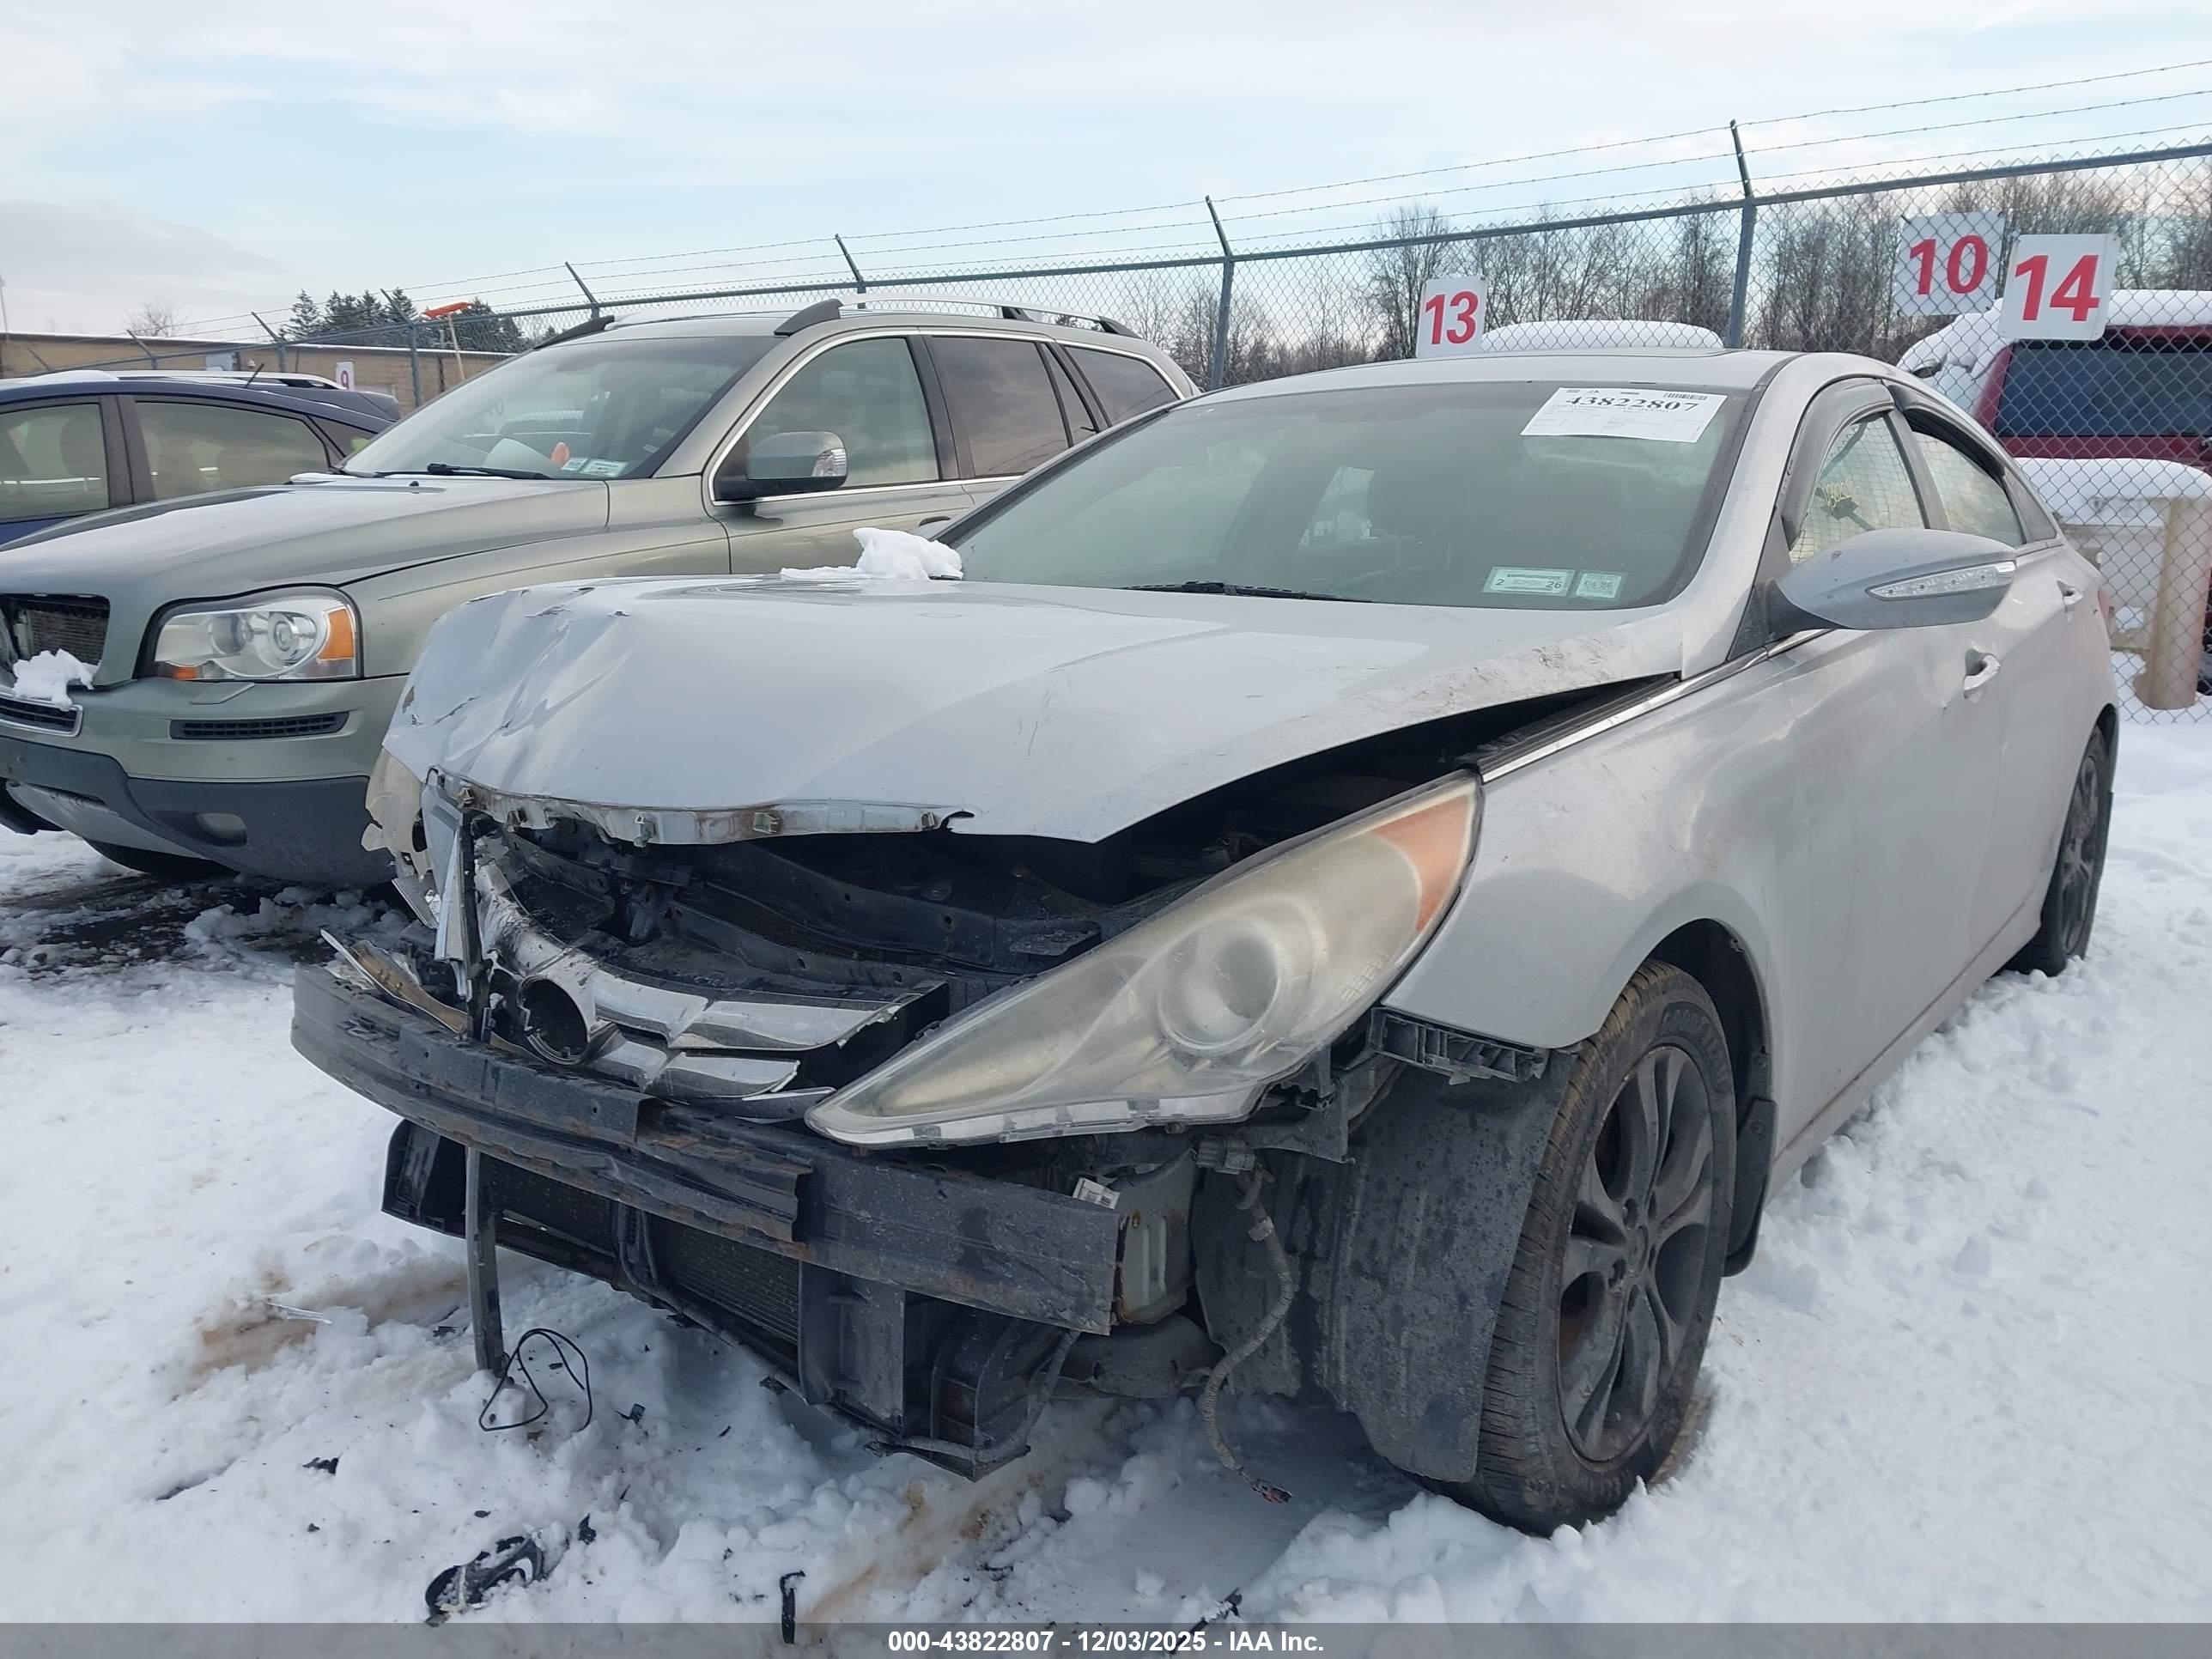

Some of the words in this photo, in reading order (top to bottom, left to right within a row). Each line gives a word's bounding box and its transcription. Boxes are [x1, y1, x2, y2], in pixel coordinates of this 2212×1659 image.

[1910, 234, 1989, 295] 10
[2014, 254, 2101, 322] 14
[1425, 290, 1479, 344] 13
[1565, 396, 1699, 412] 43822807
[1546, 580, 1563, 589] 26
